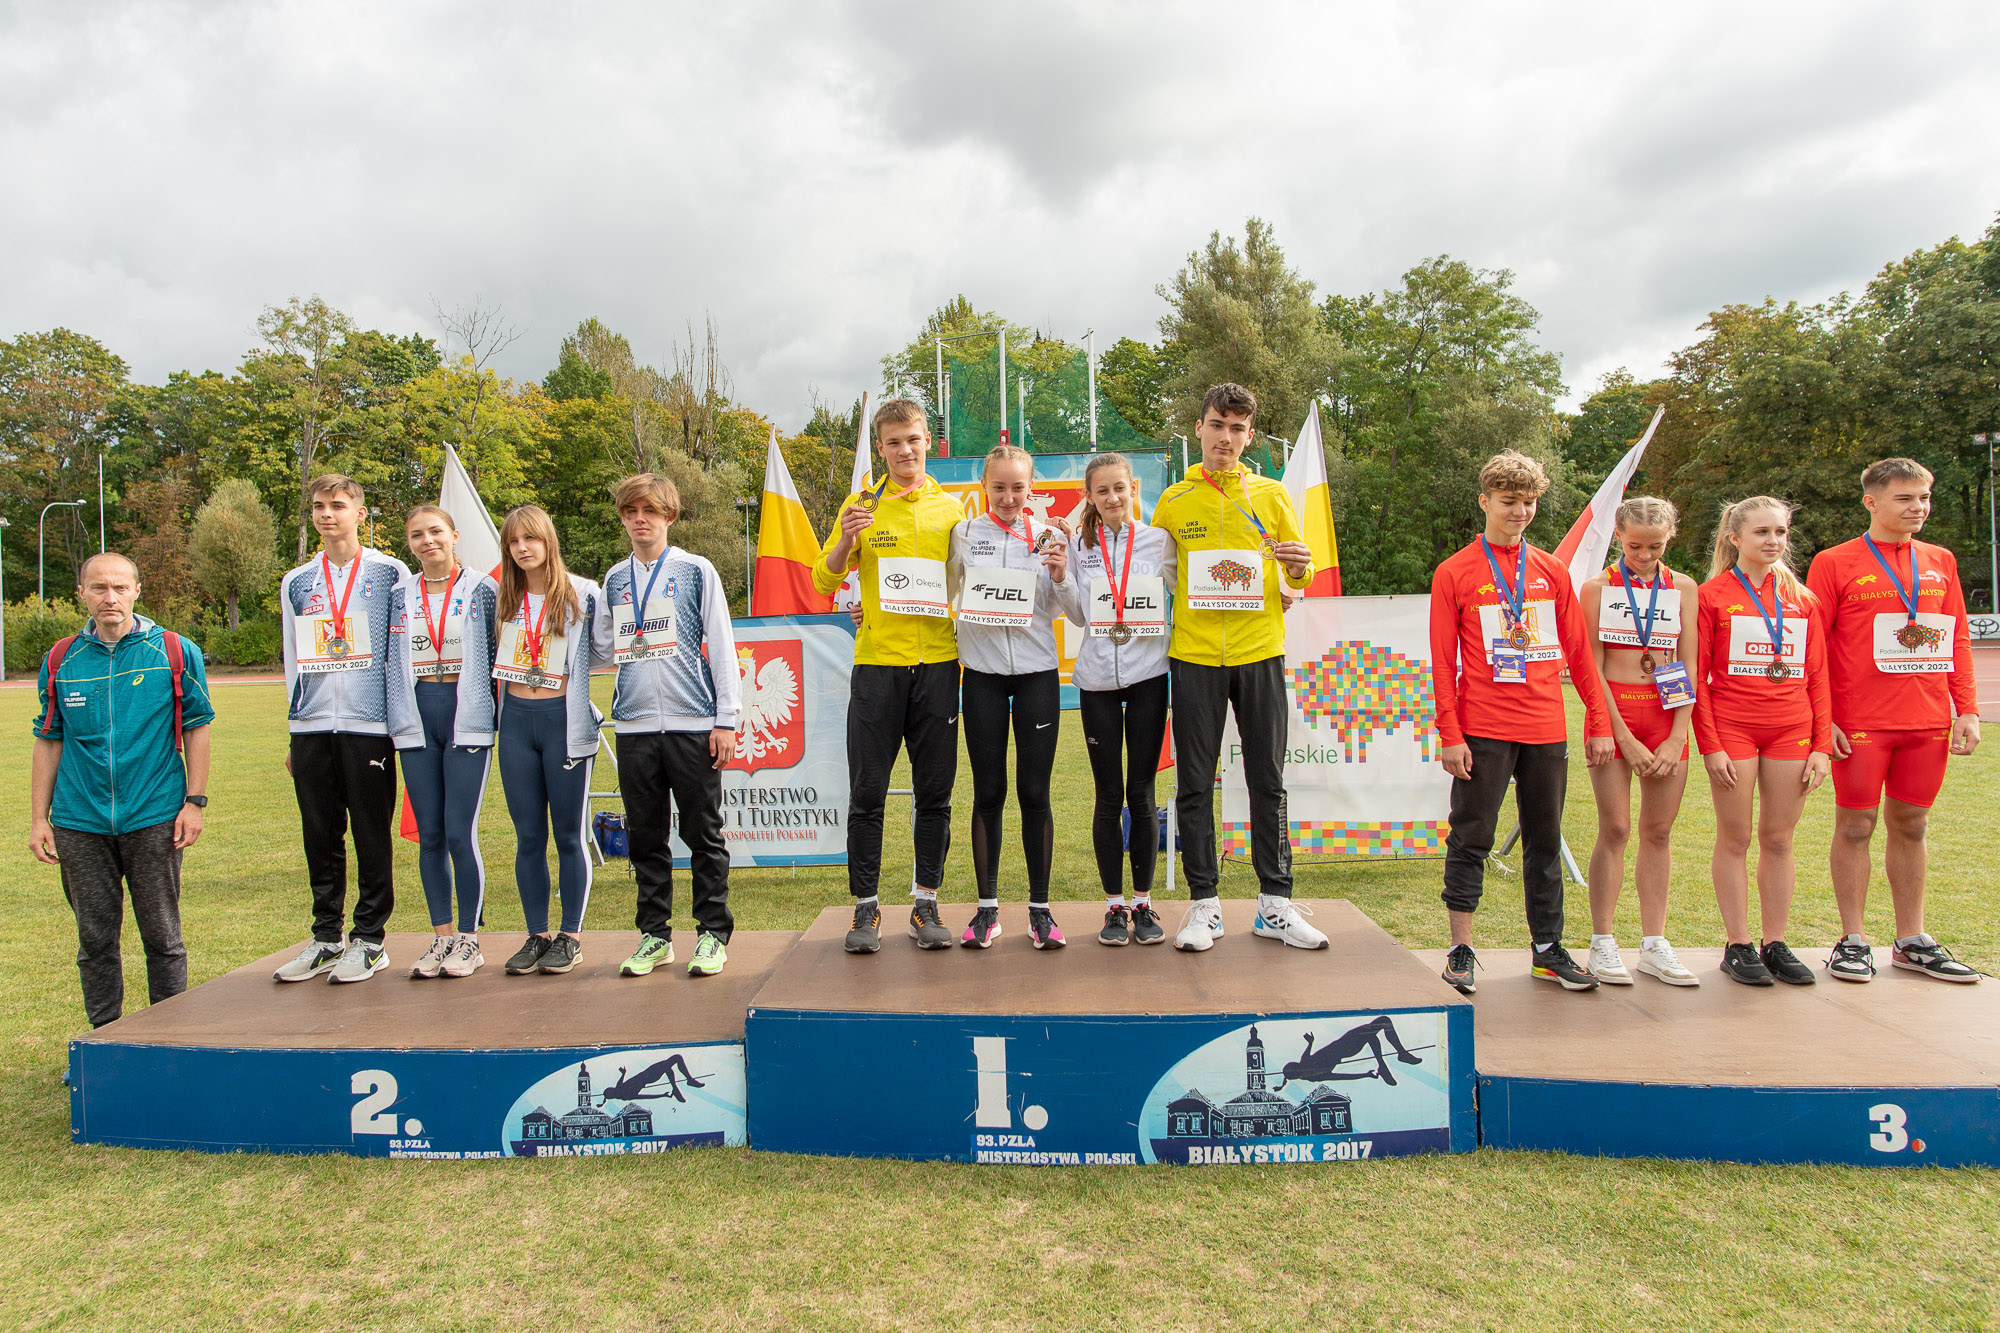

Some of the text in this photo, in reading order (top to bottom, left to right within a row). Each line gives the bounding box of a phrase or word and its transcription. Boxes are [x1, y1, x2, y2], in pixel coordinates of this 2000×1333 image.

[1179, 526, 1207, 534] FILIPIDES
[1181, 532, 1206, 540] TERESIN
[916, 578, 942, 588] Okęcie
[1848, 590, 1910, 601] KS BIAŁYSTK
[884, 604, 945, 615] BIAŁYSTOK 2022
[963, 614, 1006, 624] BIAŁYSTOK
[1603, 633, 1640, 643] BIAŁYSTO
[1651, 638, 1672, 646] 2022
[658, 648, 674, 656] 2022
[1537, 651, 1557, 659] 2022
[1748, 643, 1792, 655] ORLN
[302, 660, 369, 671] BIAŁYSTOK 2022
[515, 654, 545, 668] PZA
[1230, 744, 1338, 764] Paskie
[723, 787, 818, 806] ISTERSTWO
[738, 811, 743, 827] I
[748, 807, 839, 827] TURYSTYKI
[776, 828, 817, 842] POLSKIEJ
[973, 1036, 1049, 1131] 1.
[351, 1069, 423, 1137] 2.
[1869, 1103, 1927, 1154] 3.
[536, 1140, 668, 1157] BIAŁYSTOK 2017
[1188, 1140, 1373, 1164] BIAŁYSTOK 2017
[976, 1150, 1137, 1165] MISTRZOSTWA POLSKI
